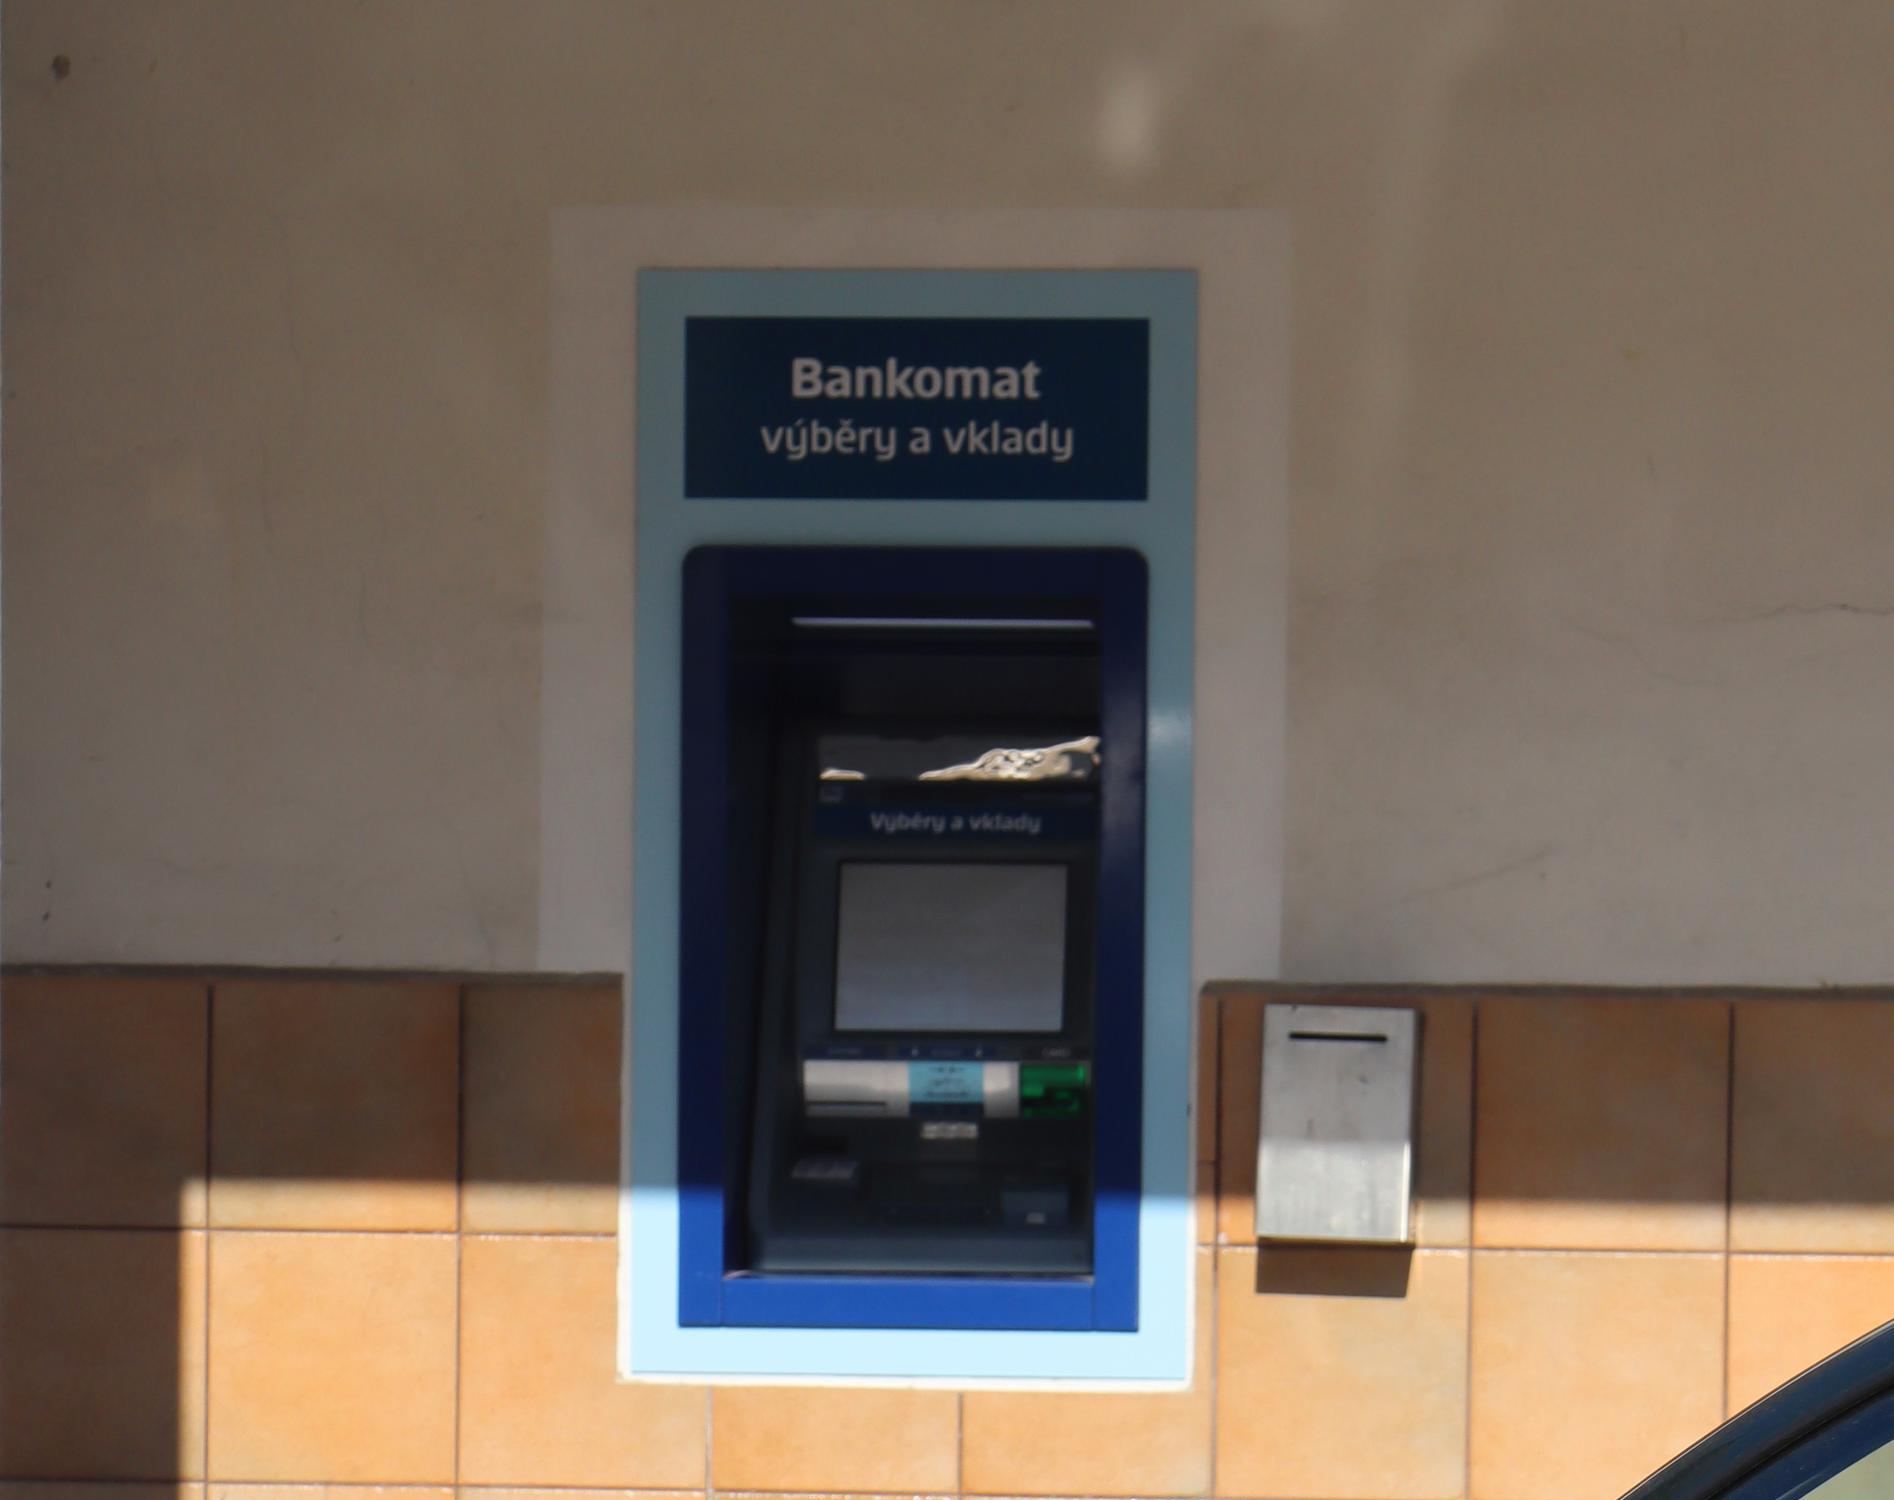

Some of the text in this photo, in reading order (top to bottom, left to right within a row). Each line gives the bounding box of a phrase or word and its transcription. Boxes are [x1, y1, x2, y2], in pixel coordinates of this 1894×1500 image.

[791, 356, 1042, 399] Bankomat
[760, 418, 1074, 462] výběry a vklady
[950, 814, 964, 831] a
[968, 813, 1042, 834] vklady
